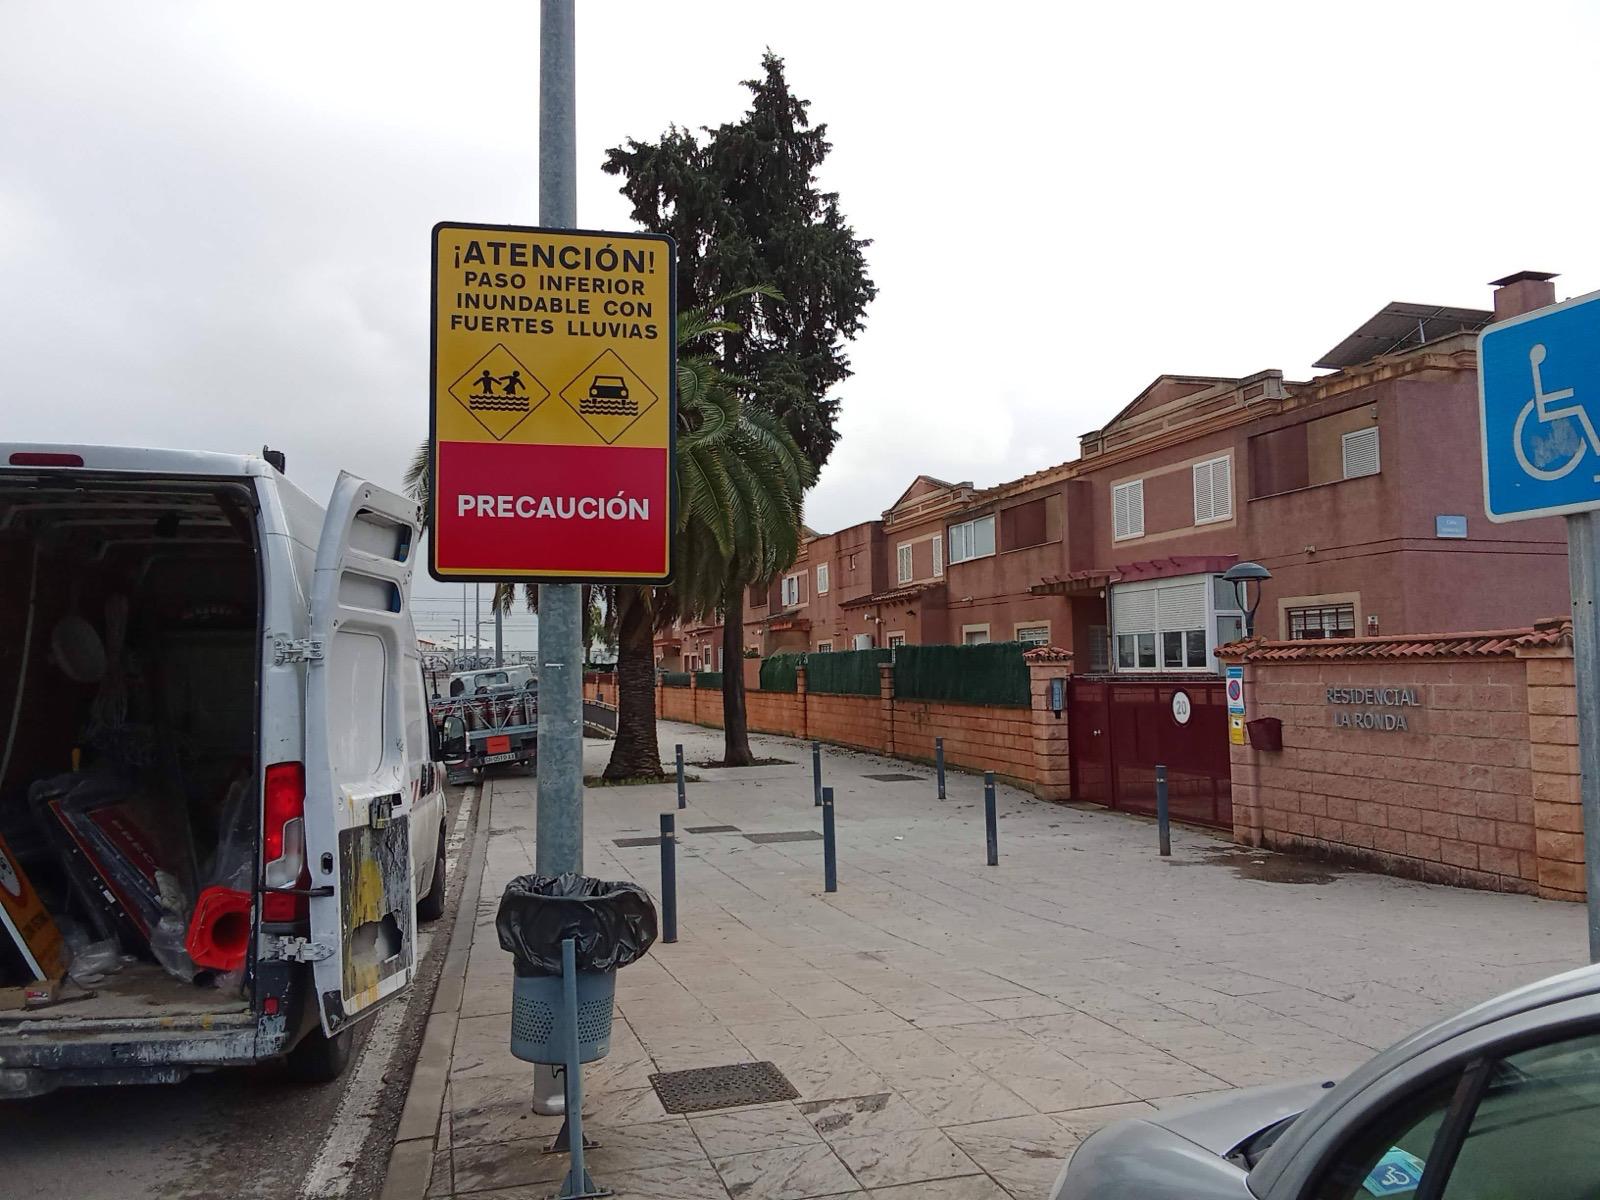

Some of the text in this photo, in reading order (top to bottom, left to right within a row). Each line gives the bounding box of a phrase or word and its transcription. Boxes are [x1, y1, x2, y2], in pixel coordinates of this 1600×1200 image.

[454, 240, 655, 274] ¡ATENCIÓN!
[464, 271, 645, 296] PASO INFERIOR
[457, 293, 652, 318] INUNDABLE CON
[451, 314, 658, 340] FUERTES LLUVIAS
[457, 490, 649, 521] PRECAUCIÓN
[1326, 687, 1421, 707] RESIDENCIAL
[1334, 712, 1409, 731] LA RONDA
